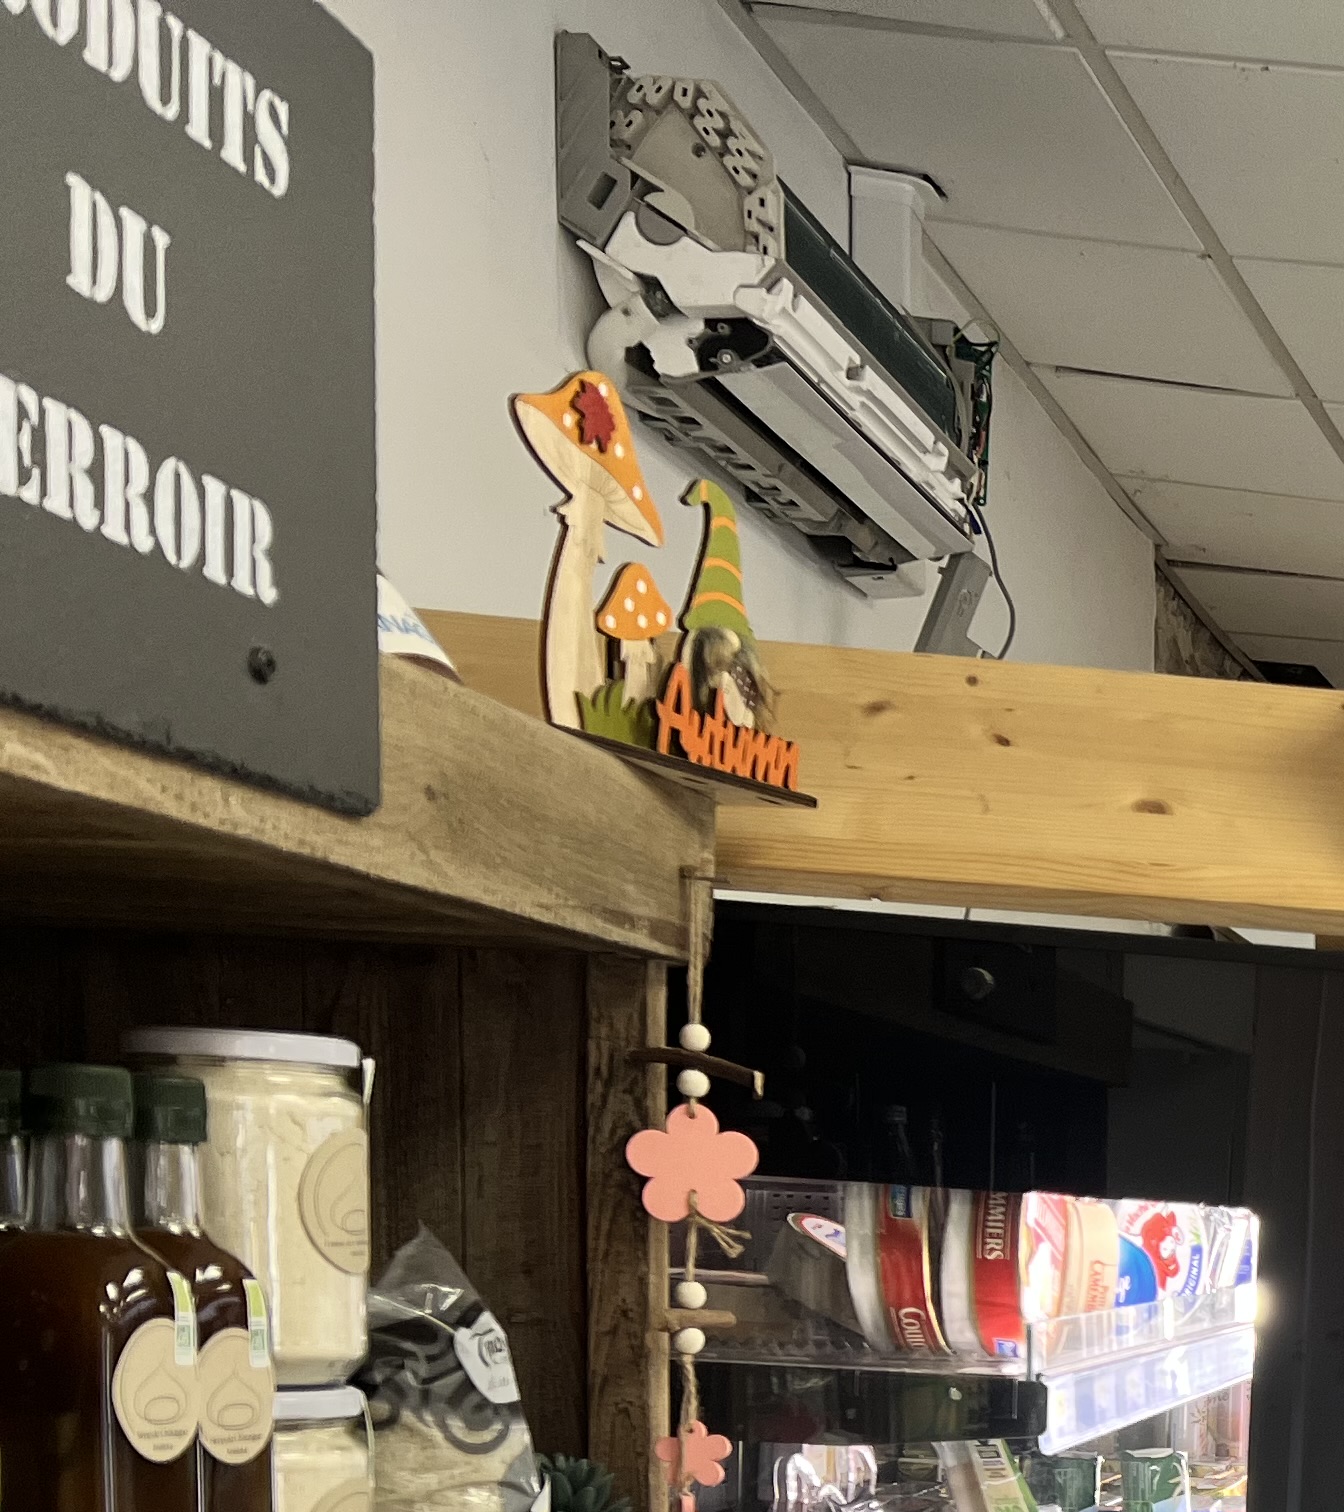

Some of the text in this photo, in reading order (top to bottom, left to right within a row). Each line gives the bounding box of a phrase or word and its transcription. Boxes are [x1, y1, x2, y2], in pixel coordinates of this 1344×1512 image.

[3, 0, 289, 198] DUITS
[65, 171, 171, 334] DU
[656, 662, 801, 783] Autumn
